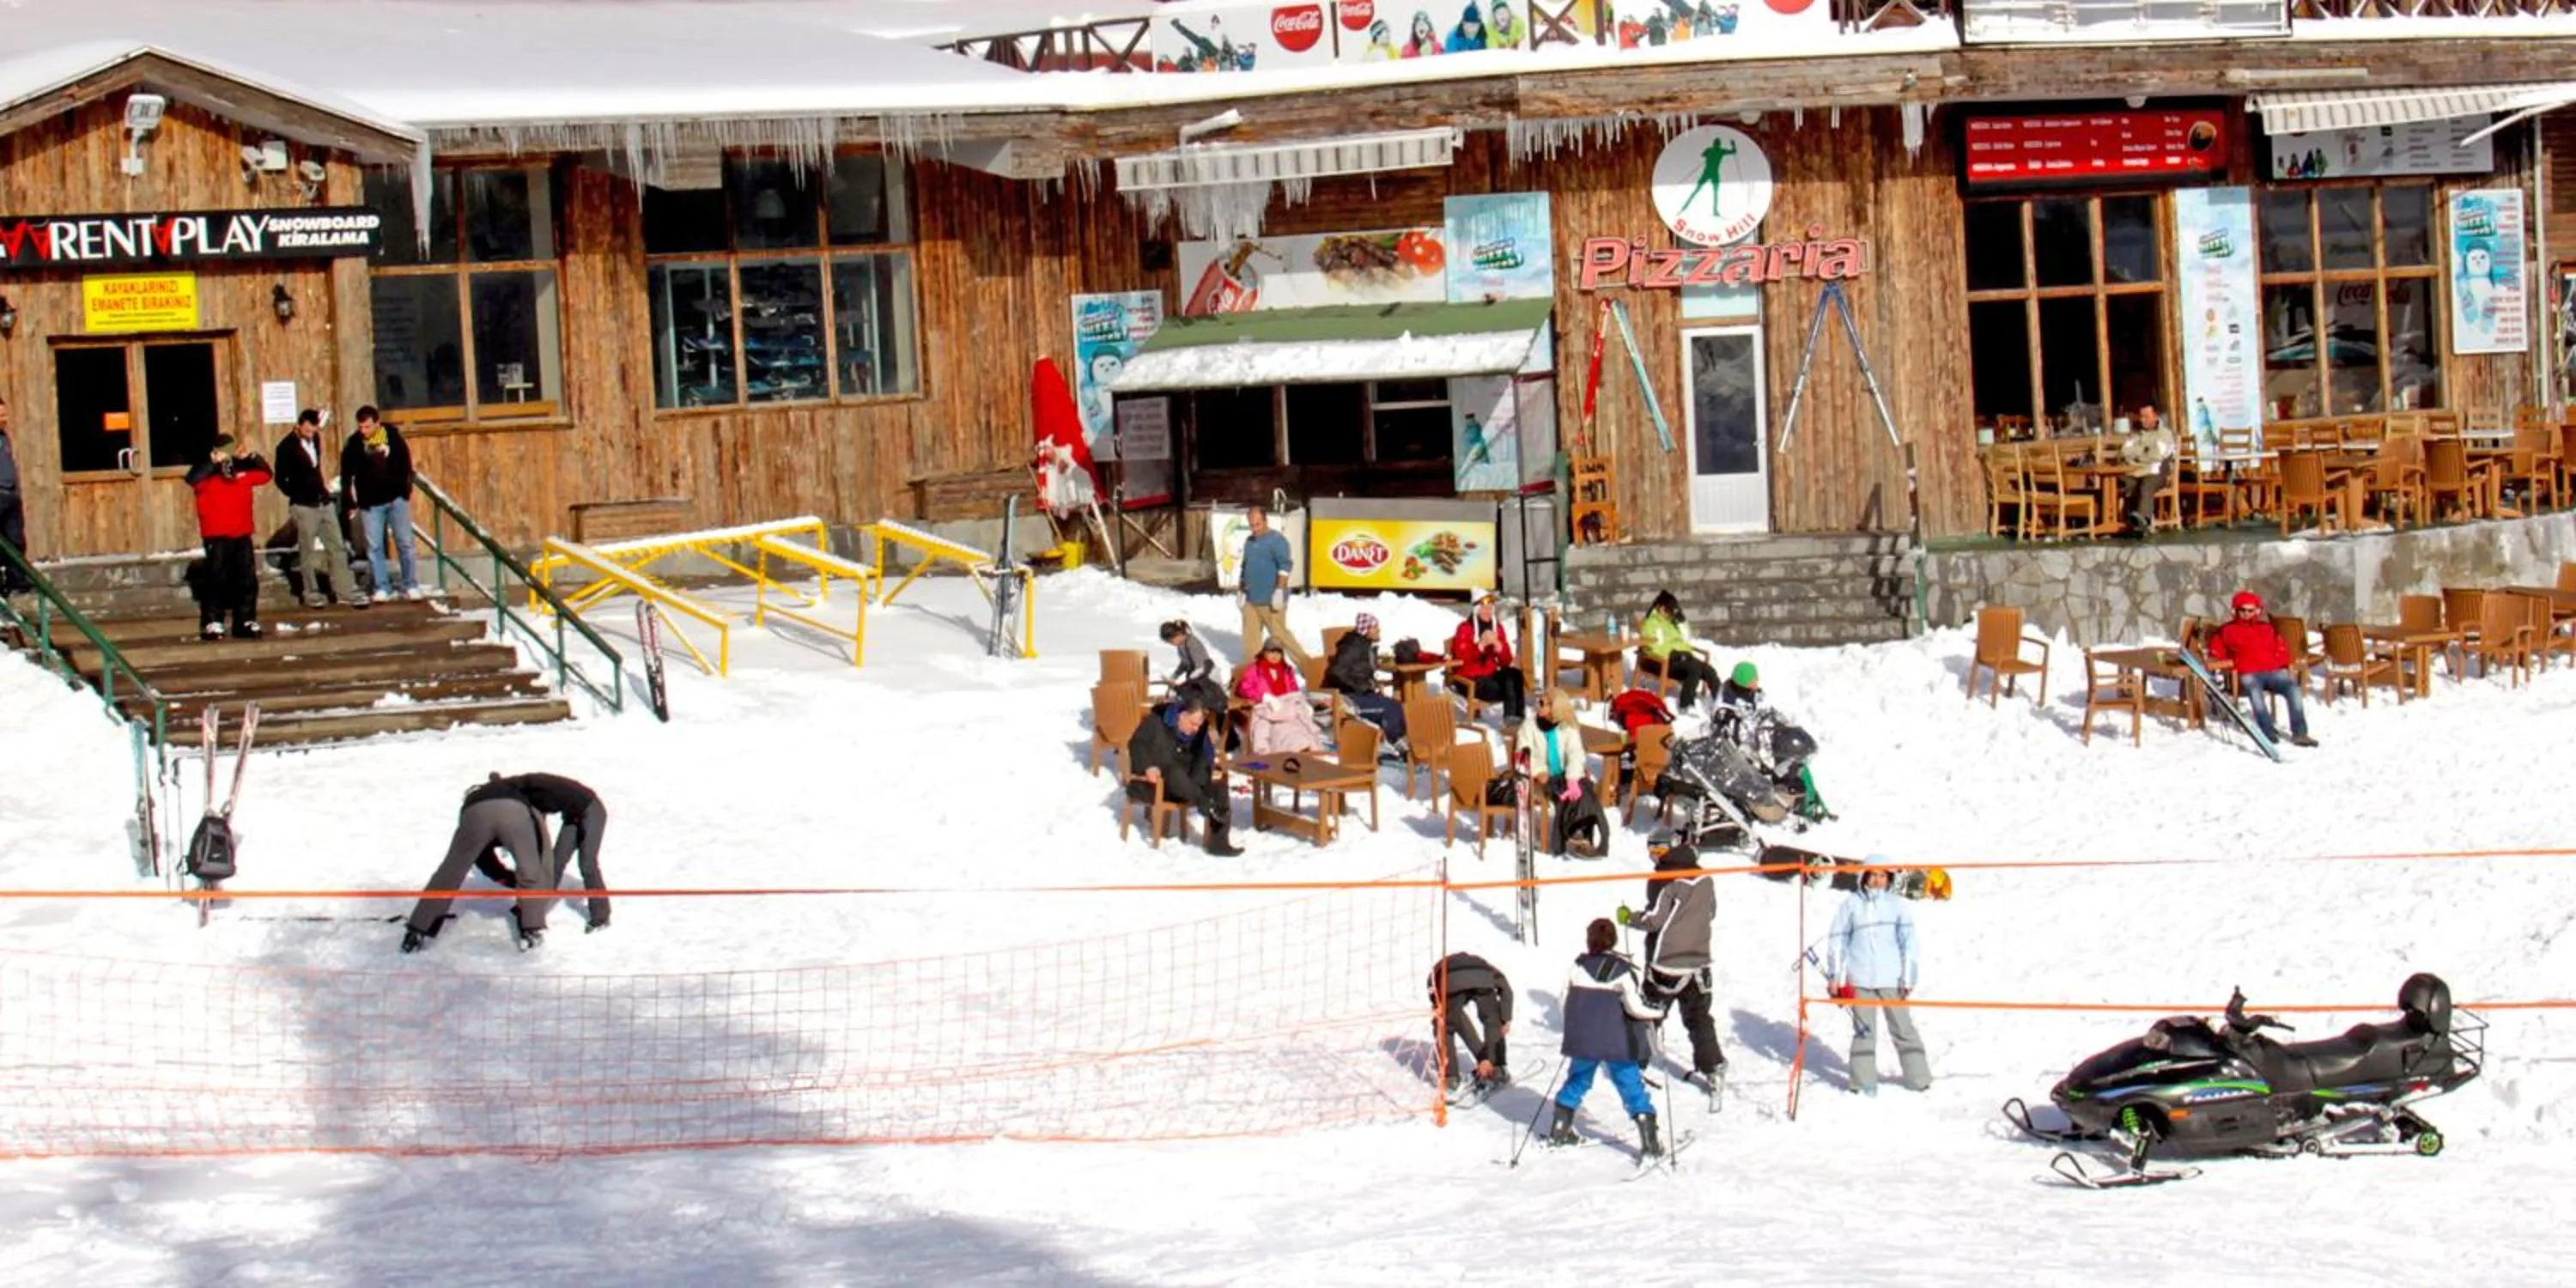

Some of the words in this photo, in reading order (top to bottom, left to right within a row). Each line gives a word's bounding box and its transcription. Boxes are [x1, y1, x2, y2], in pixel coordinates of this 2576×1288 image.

[172, 214, 270, 256] PLAY
[268, 215, 380, 233] SNOWBOARD
[1674, 219, 1721, 242] Snow
[1726, 212, 1755, 239] Hill
[1580, 223, 1863, 290] Pizzaria
